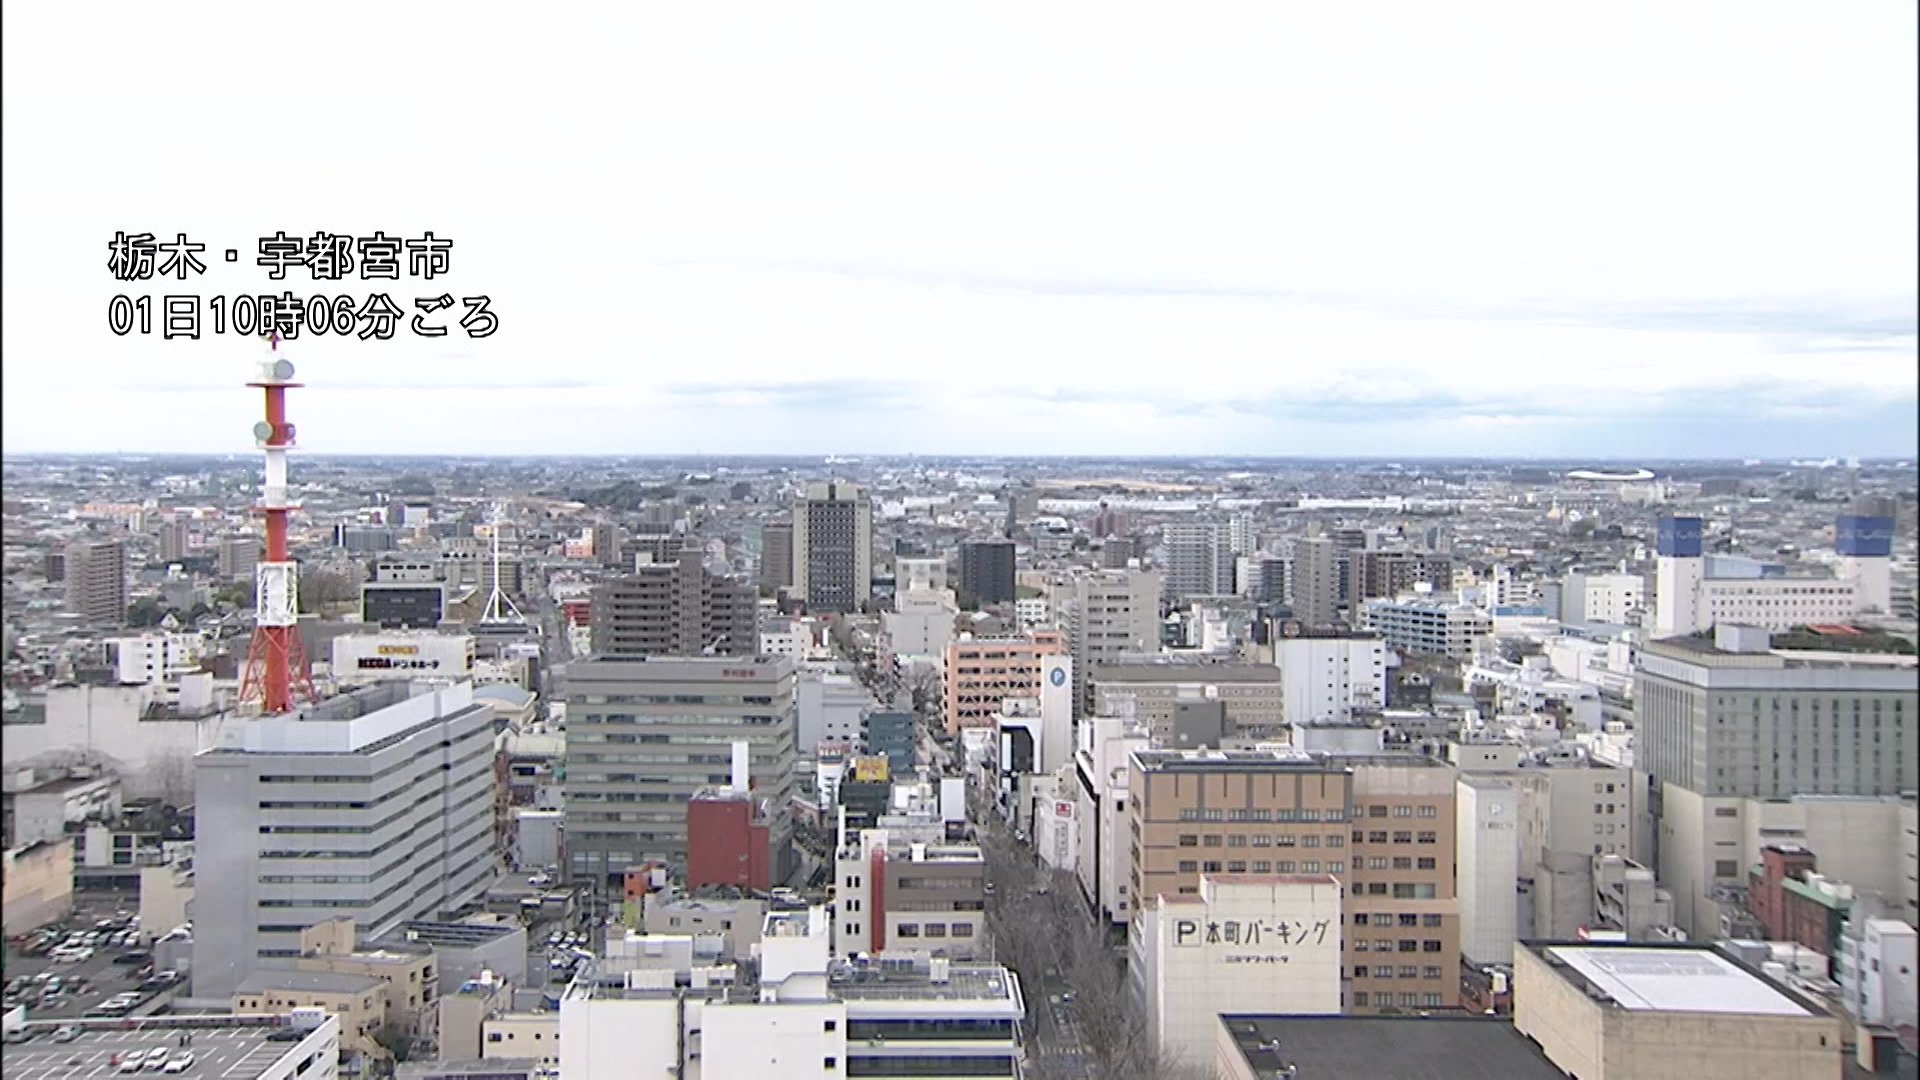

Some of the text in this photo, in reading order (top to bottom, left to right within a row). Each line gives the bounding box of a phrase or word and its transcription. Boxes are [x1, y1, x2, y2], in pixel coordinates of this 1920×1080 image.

[1178, 919, 1330, 945] P 本町パーキング
